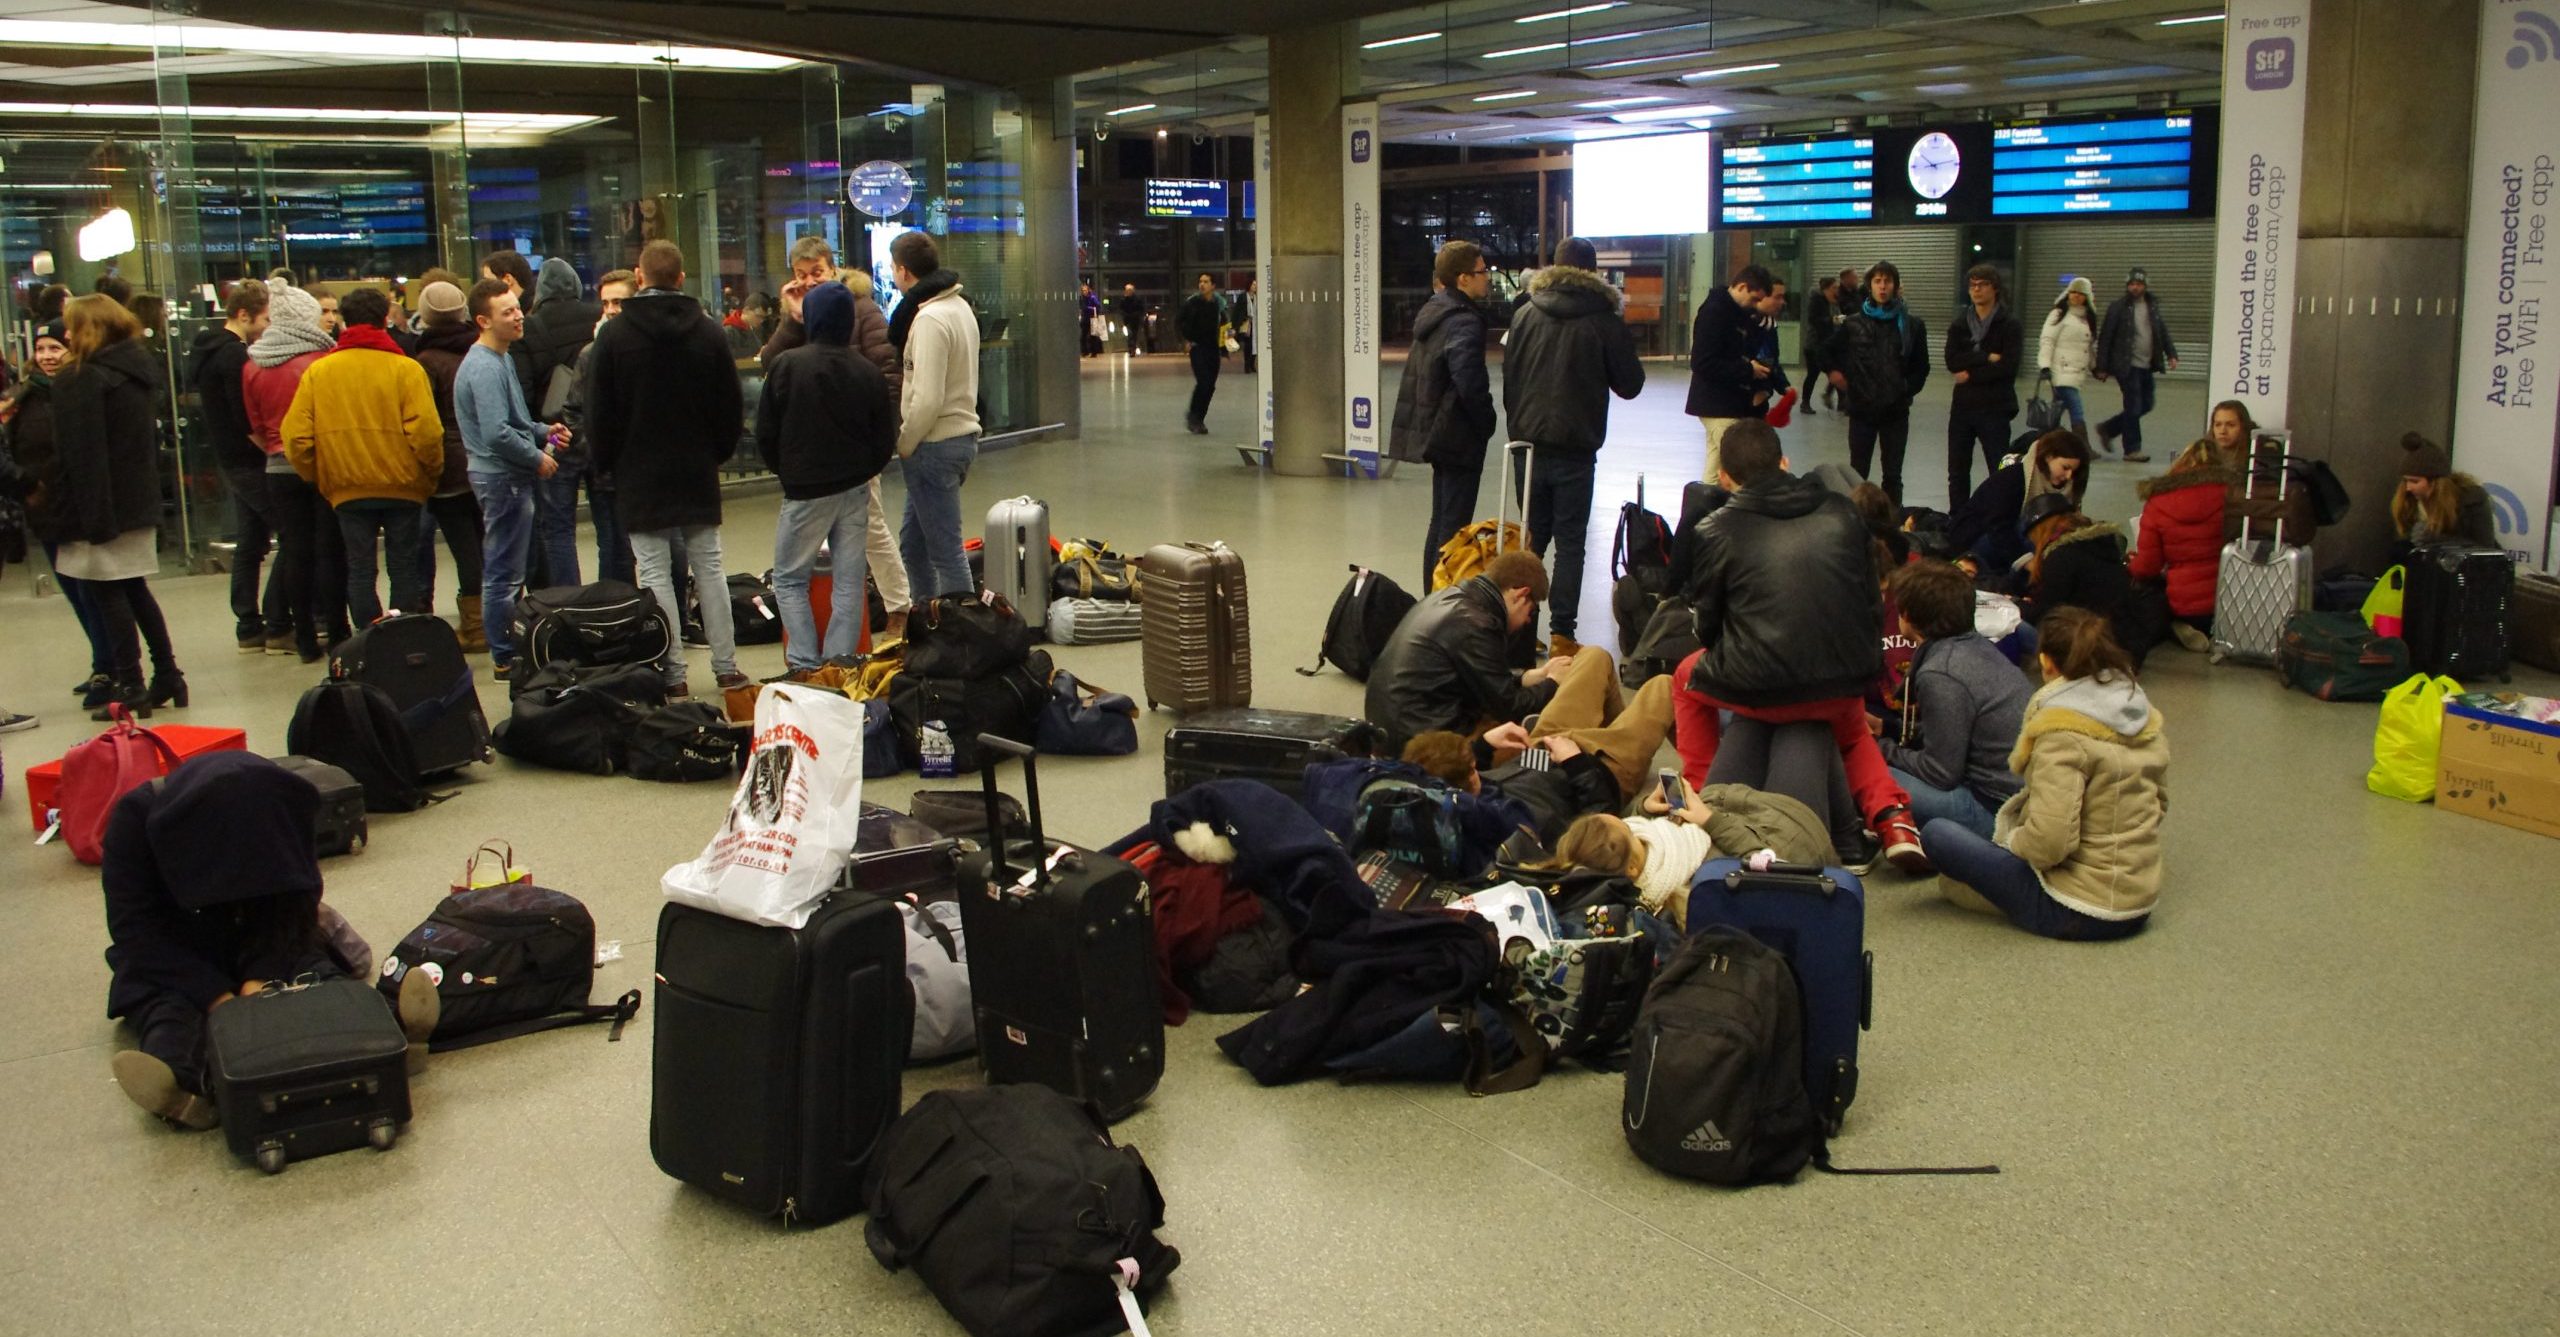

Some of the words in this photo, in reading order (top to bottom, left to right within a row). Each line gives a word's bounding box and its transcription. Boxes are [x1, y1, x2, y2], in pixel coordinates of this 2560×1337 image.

[2241, 18, 2269, 30] Free
[2273, 15, 2301, 28] app
[2255, 49, 2286, 71] StP
[2247, 154, 2266, 197] app
[2532, 154, 2555, 206] app
[1354, 202, 1362, 230] app
[2242, 204, 2259, 243] free
[2496, 164, 2523, 305] connected?
[2523, 214, 2546, 266] Free
[2241, 250, 2257, 282] the
[2256, 166, 2285, 368] stpancras.com/app
[2234, 290, 2254, 395] Download
[2494, 313, 2514, 357] you
[2516, 297, 2540, 350] WiFi
[2255, 374, 2270, 396] at
[2486, 364, 2508, 408] Are
[2511, 358, 2534, 409] Free
[1881, 634, 1917, 650] NDO
[1681, 1139, 1732, 1152] adidas
